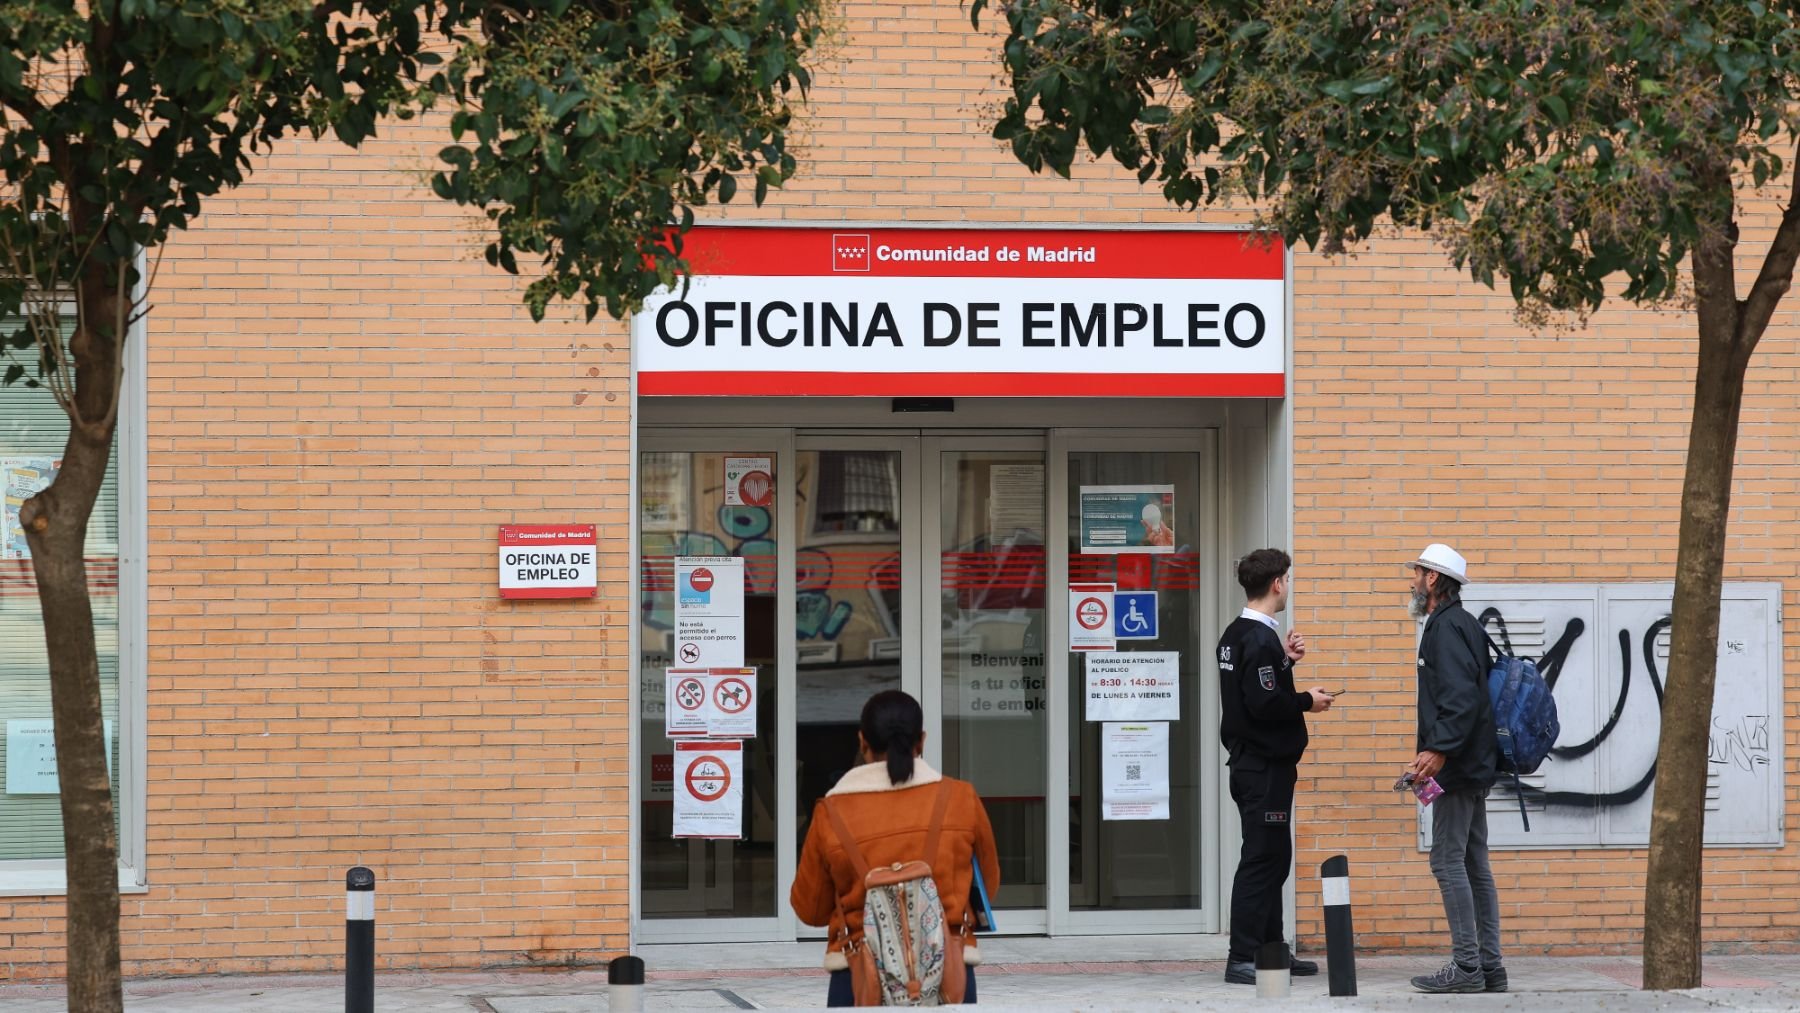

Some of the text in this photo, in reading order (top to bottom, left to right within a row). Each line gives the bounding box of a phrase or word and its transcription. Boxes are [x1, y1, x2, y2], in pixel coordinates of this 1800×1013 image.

[876, 245, 1095, 262] Comunidad de Madrid
[655, 300, 1266, 348] OFICINA DE EMPLEO
[506, 553, 590, 565] OFICINA DE
[518, 568, 579, 580] EMPLEO
[971, 680, 980, 690] a
[986, 678, 1003, 690] tu
[971, 698, 992, 710] de
